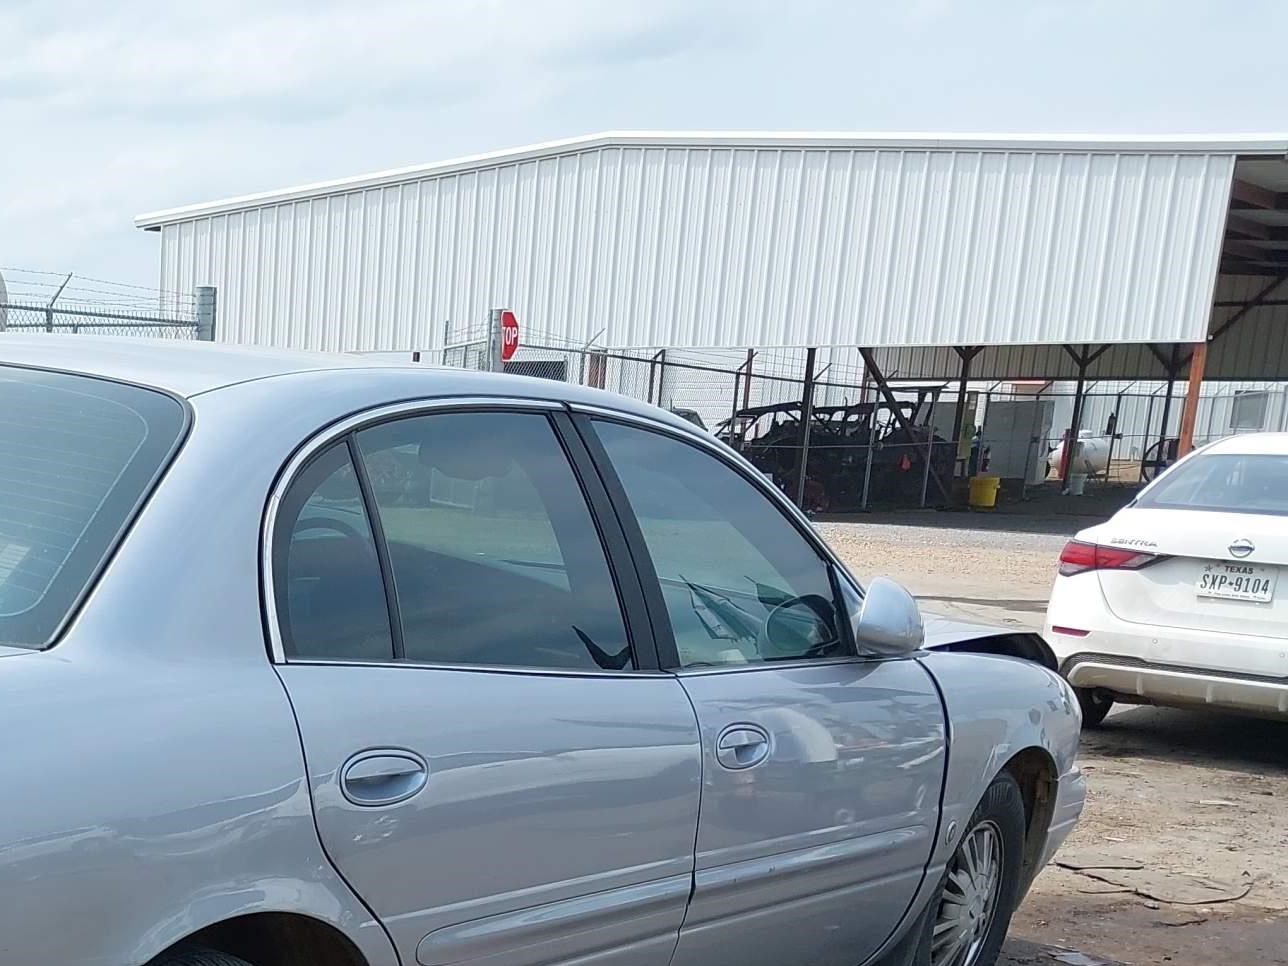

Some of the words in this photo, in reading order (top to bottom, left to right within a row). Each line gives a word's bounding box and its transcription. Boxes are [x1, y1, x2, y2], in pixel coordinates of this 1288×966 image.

[502, 326, 518, 346] TOP
[1110, 537, 1158, 549] SENTRA
[1224, 565, 1254, 575] TEXAS
